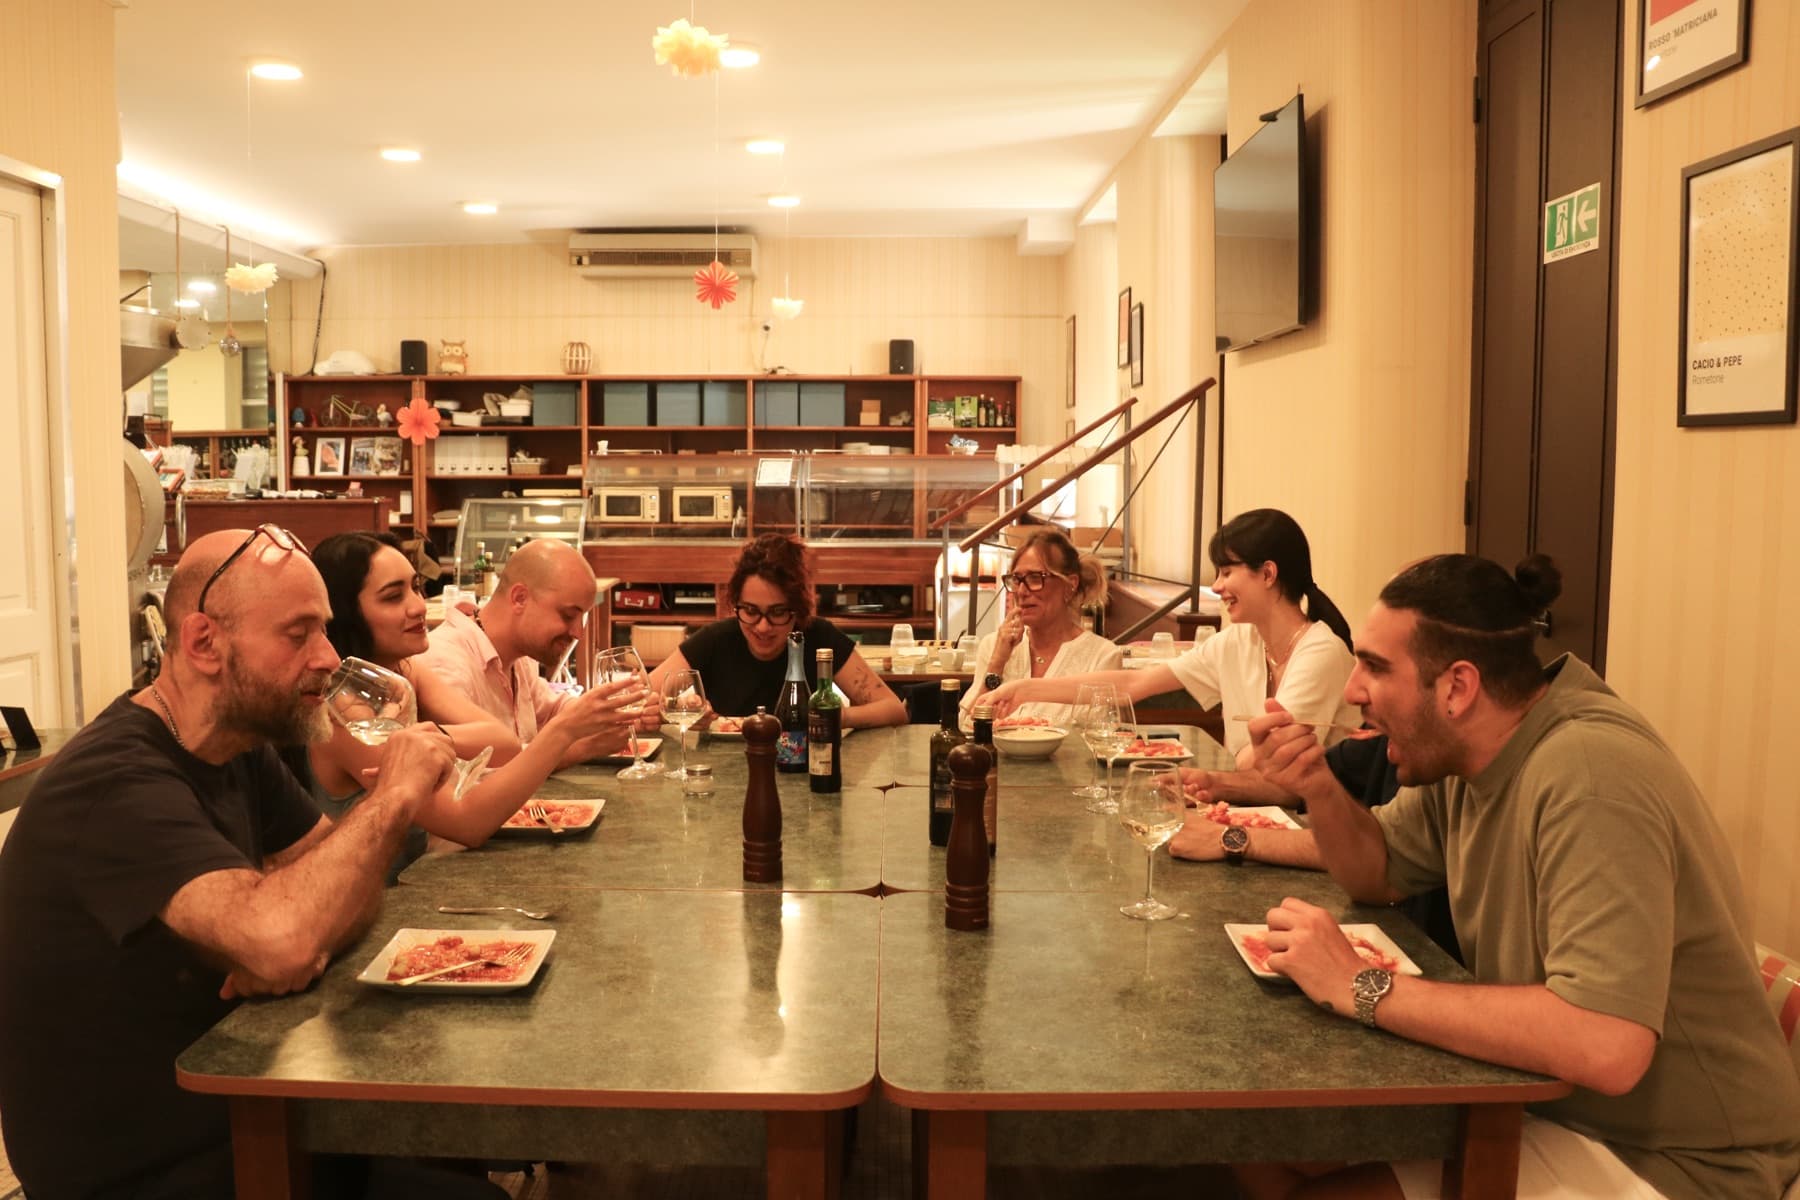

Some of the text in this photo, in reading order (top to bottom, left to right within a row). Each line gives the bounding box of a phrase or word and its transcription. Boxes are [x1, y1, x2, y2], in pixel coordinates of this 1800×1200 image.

[1648, 32, 1671, 50] ROSSO
[1692, 355, 1743, 370] CACIO & PEPE
